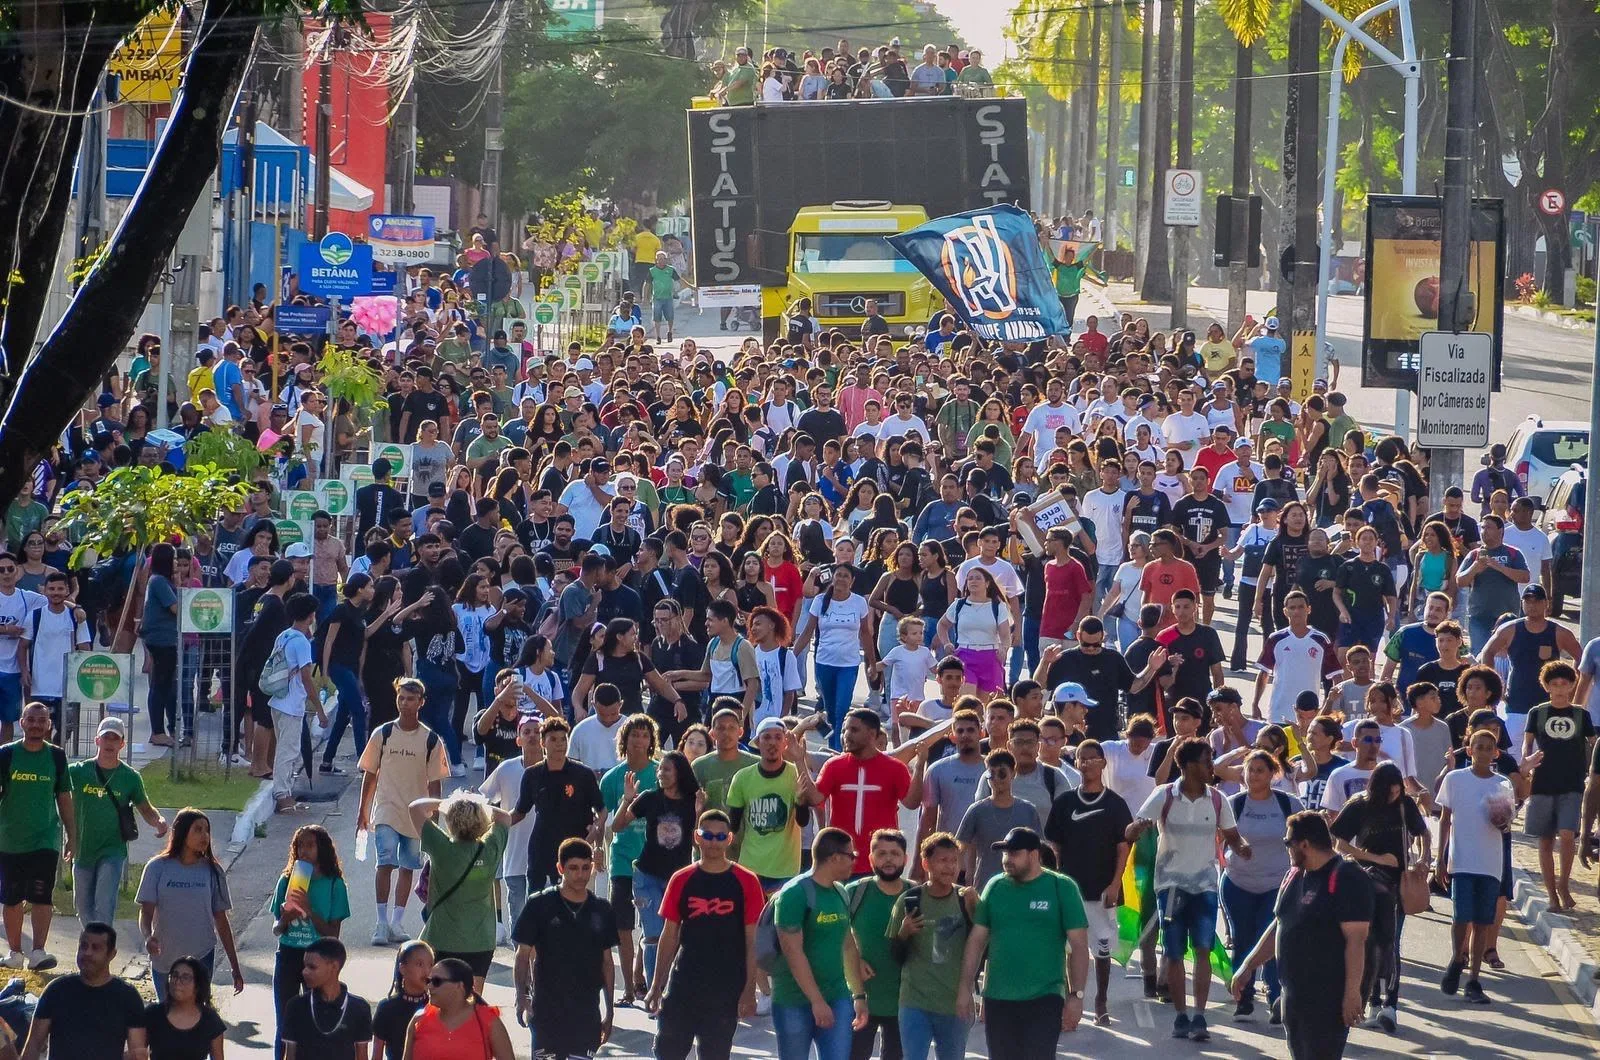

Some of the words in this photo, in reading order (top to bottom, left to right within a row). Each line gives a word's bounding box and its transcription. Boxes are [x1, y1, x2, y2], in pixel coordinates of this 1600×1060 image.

[976, 104, 1011, 205] STAT
[708, 112, 741, 282] STATUS
[311, 266, 359, 278] BETÂNIA
[1448, 343, 1465, 359] Via
[1425, 367, 1486, 384] Fiscalizada
[1422, 395, 1437, 411] por
[1438, 391, 1474, 409] Câmeras
[1476, 394, 1486, 409] de
[1420, 419, 1485, 436] Monitoramento
[750, 797, 778, 813] AVAN
